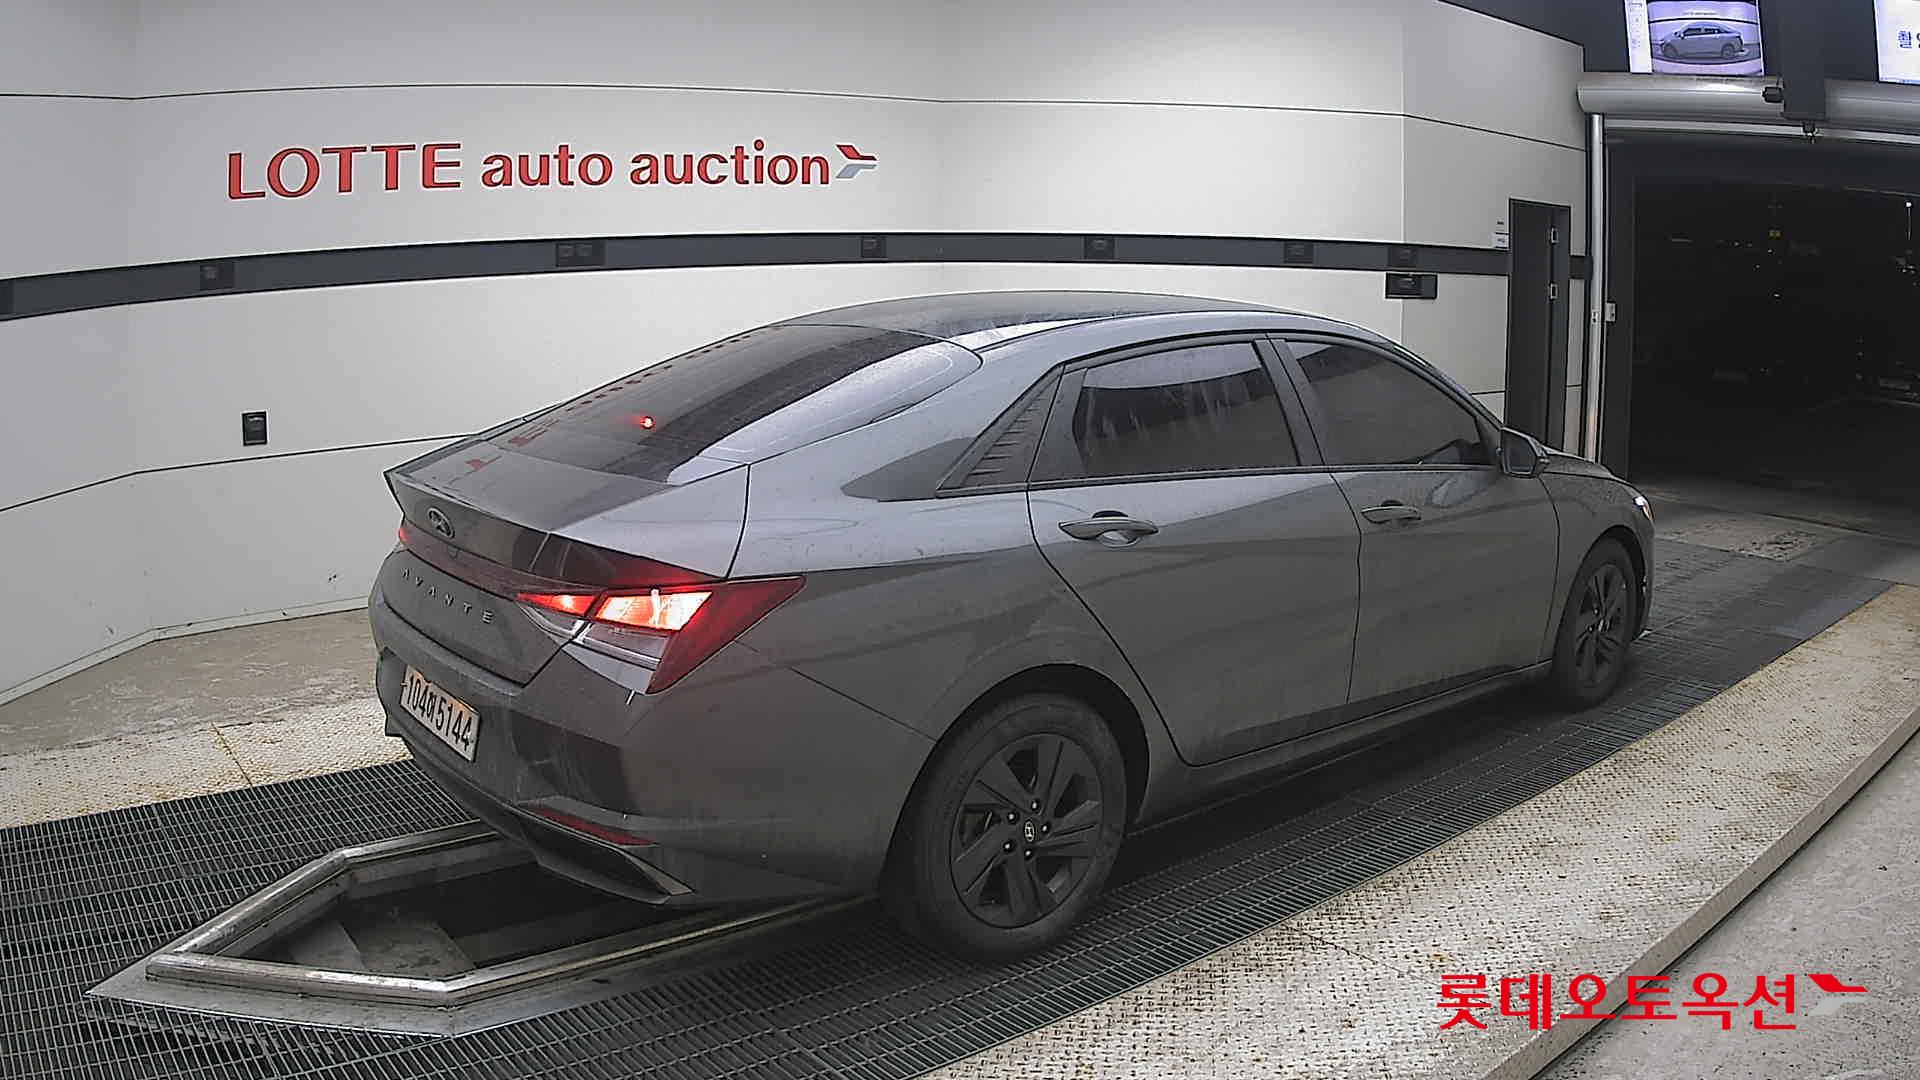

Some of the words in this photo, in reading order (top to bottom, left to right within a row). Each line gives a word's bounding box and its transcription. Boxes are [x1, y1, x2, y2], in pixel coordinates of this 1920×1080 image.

[227, 143, 462, 201] LOTTE
[481, 144, 612, 188] auto
[630, 139, 830, 187] auction
[402, 567, 496, 625] AVANTE
